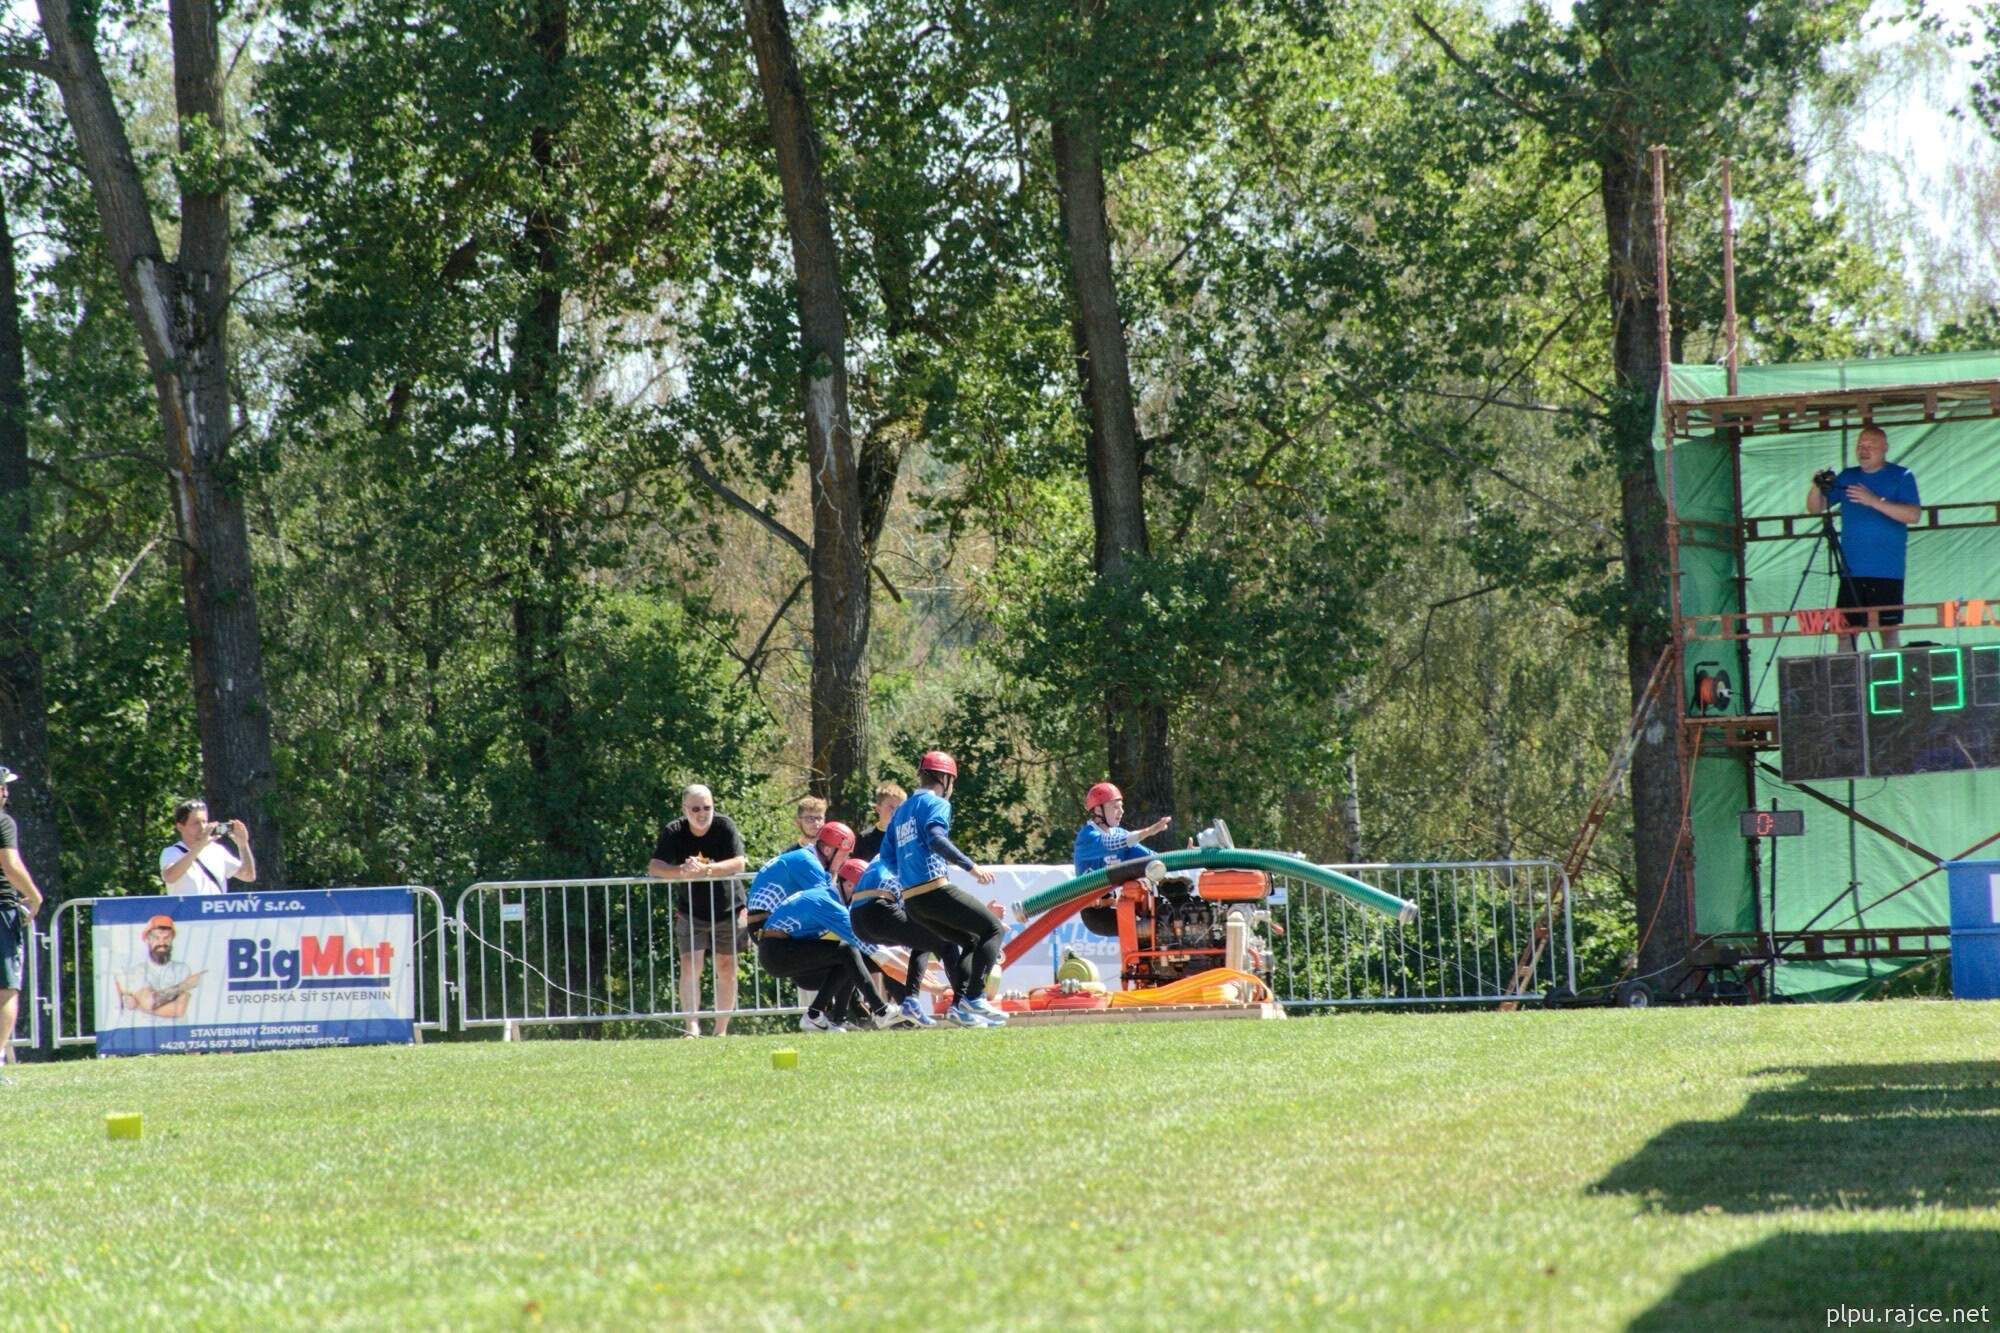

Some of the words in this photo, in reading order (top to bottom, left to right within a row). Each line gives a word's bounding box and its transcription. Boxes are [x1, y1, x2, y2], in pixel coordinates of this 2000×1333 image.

[201, 896, 261, 913] PEVNÝ
[264, 900, 305, 911] s.r.o.
[228, 935, 395, 989] BigMat
[227, 990, 296, 1004] EVROPSKÁ
[300, 990, 318, 1002] SÍŤ
[321, 991, 391, 1002] STAVEBNIN
[190, 1026, 258, 1038] STAVEBNINY
[260, 1024, 319, 1035] ŽIROVNICE
[160, 1041, 185, 1050] +420
